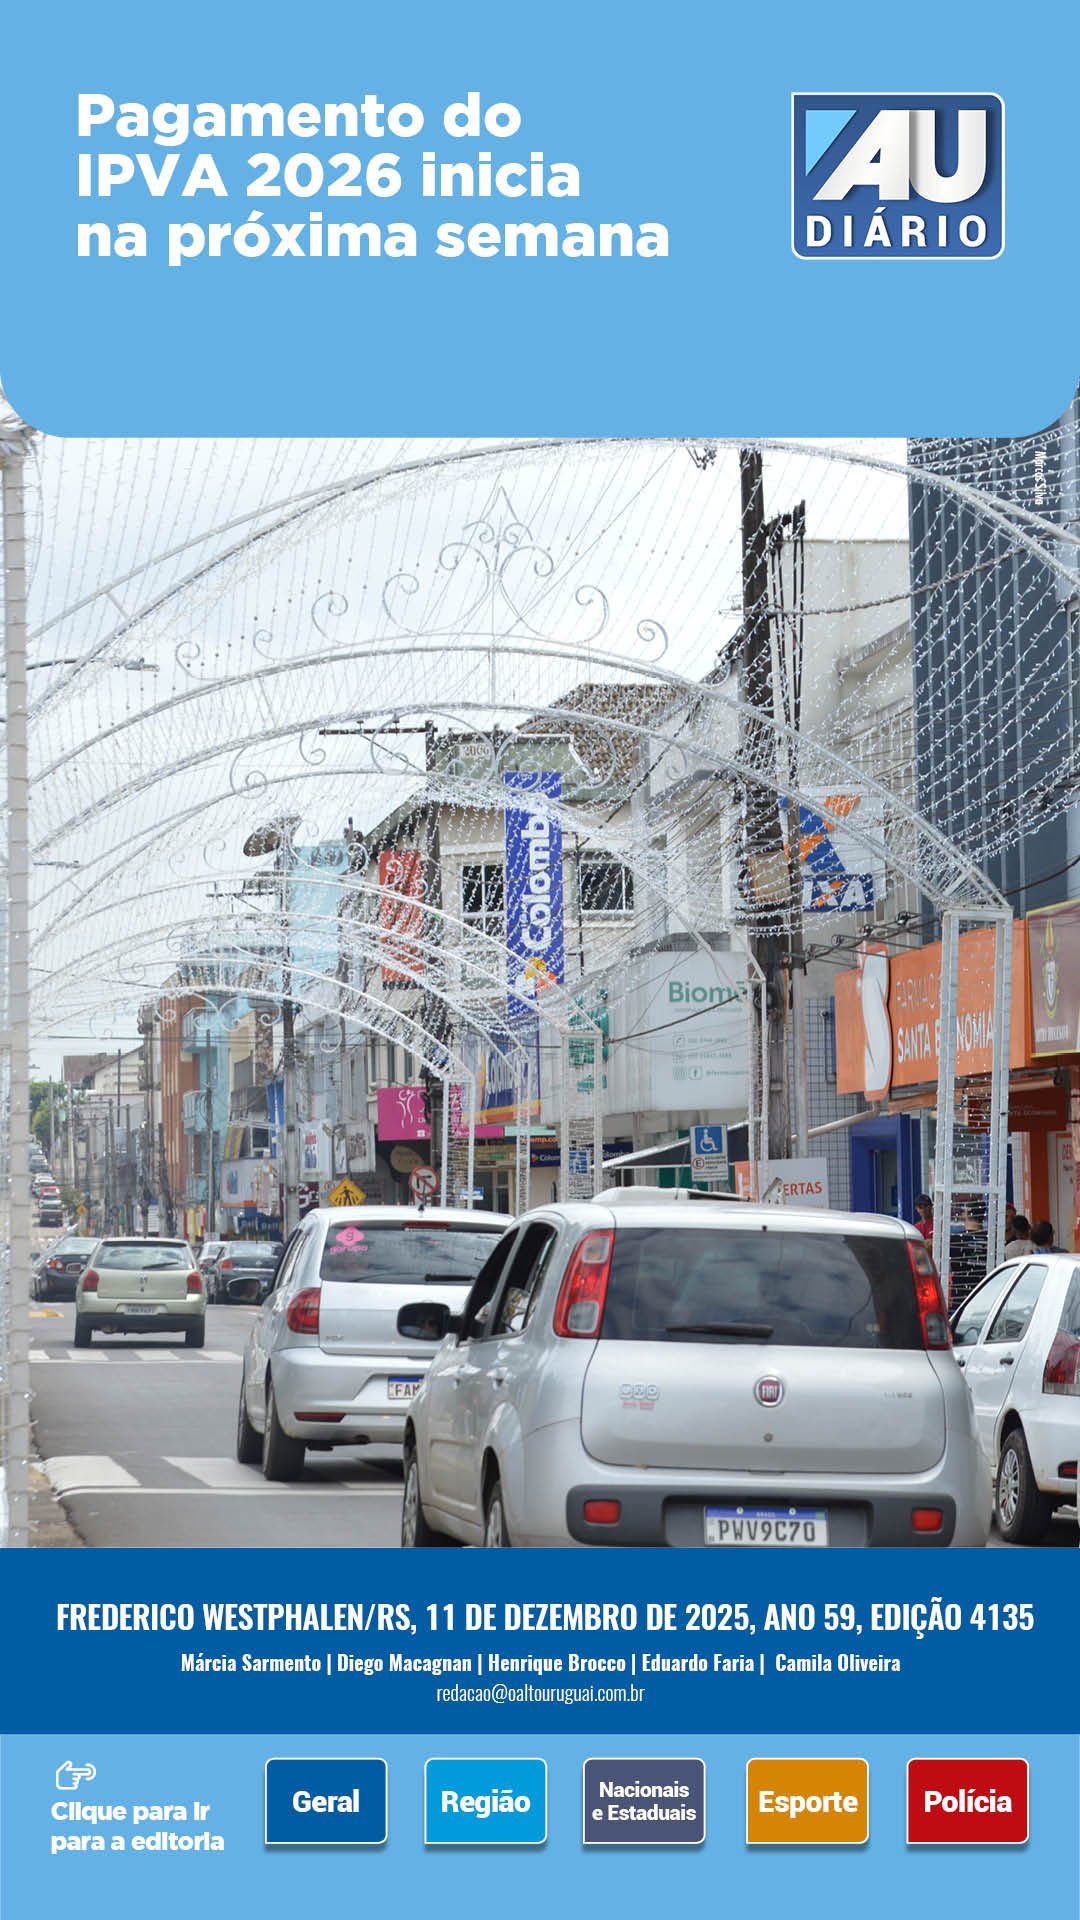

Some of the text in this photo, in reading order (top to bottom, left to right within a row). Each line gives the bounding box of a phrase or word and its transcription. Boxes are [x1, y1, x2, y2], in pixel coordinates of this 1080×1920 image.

[802, 877, 867, 908] IXA
[896, 1023, 932, 1064] SANTA
[934, 1008, 996, 1056] ENOMIA
[783, 1181, 823, 1196] ERTAS
[761, 1384, 779, 1401] FIAT
[718, 1519, 816, 1543] PWV9C70
